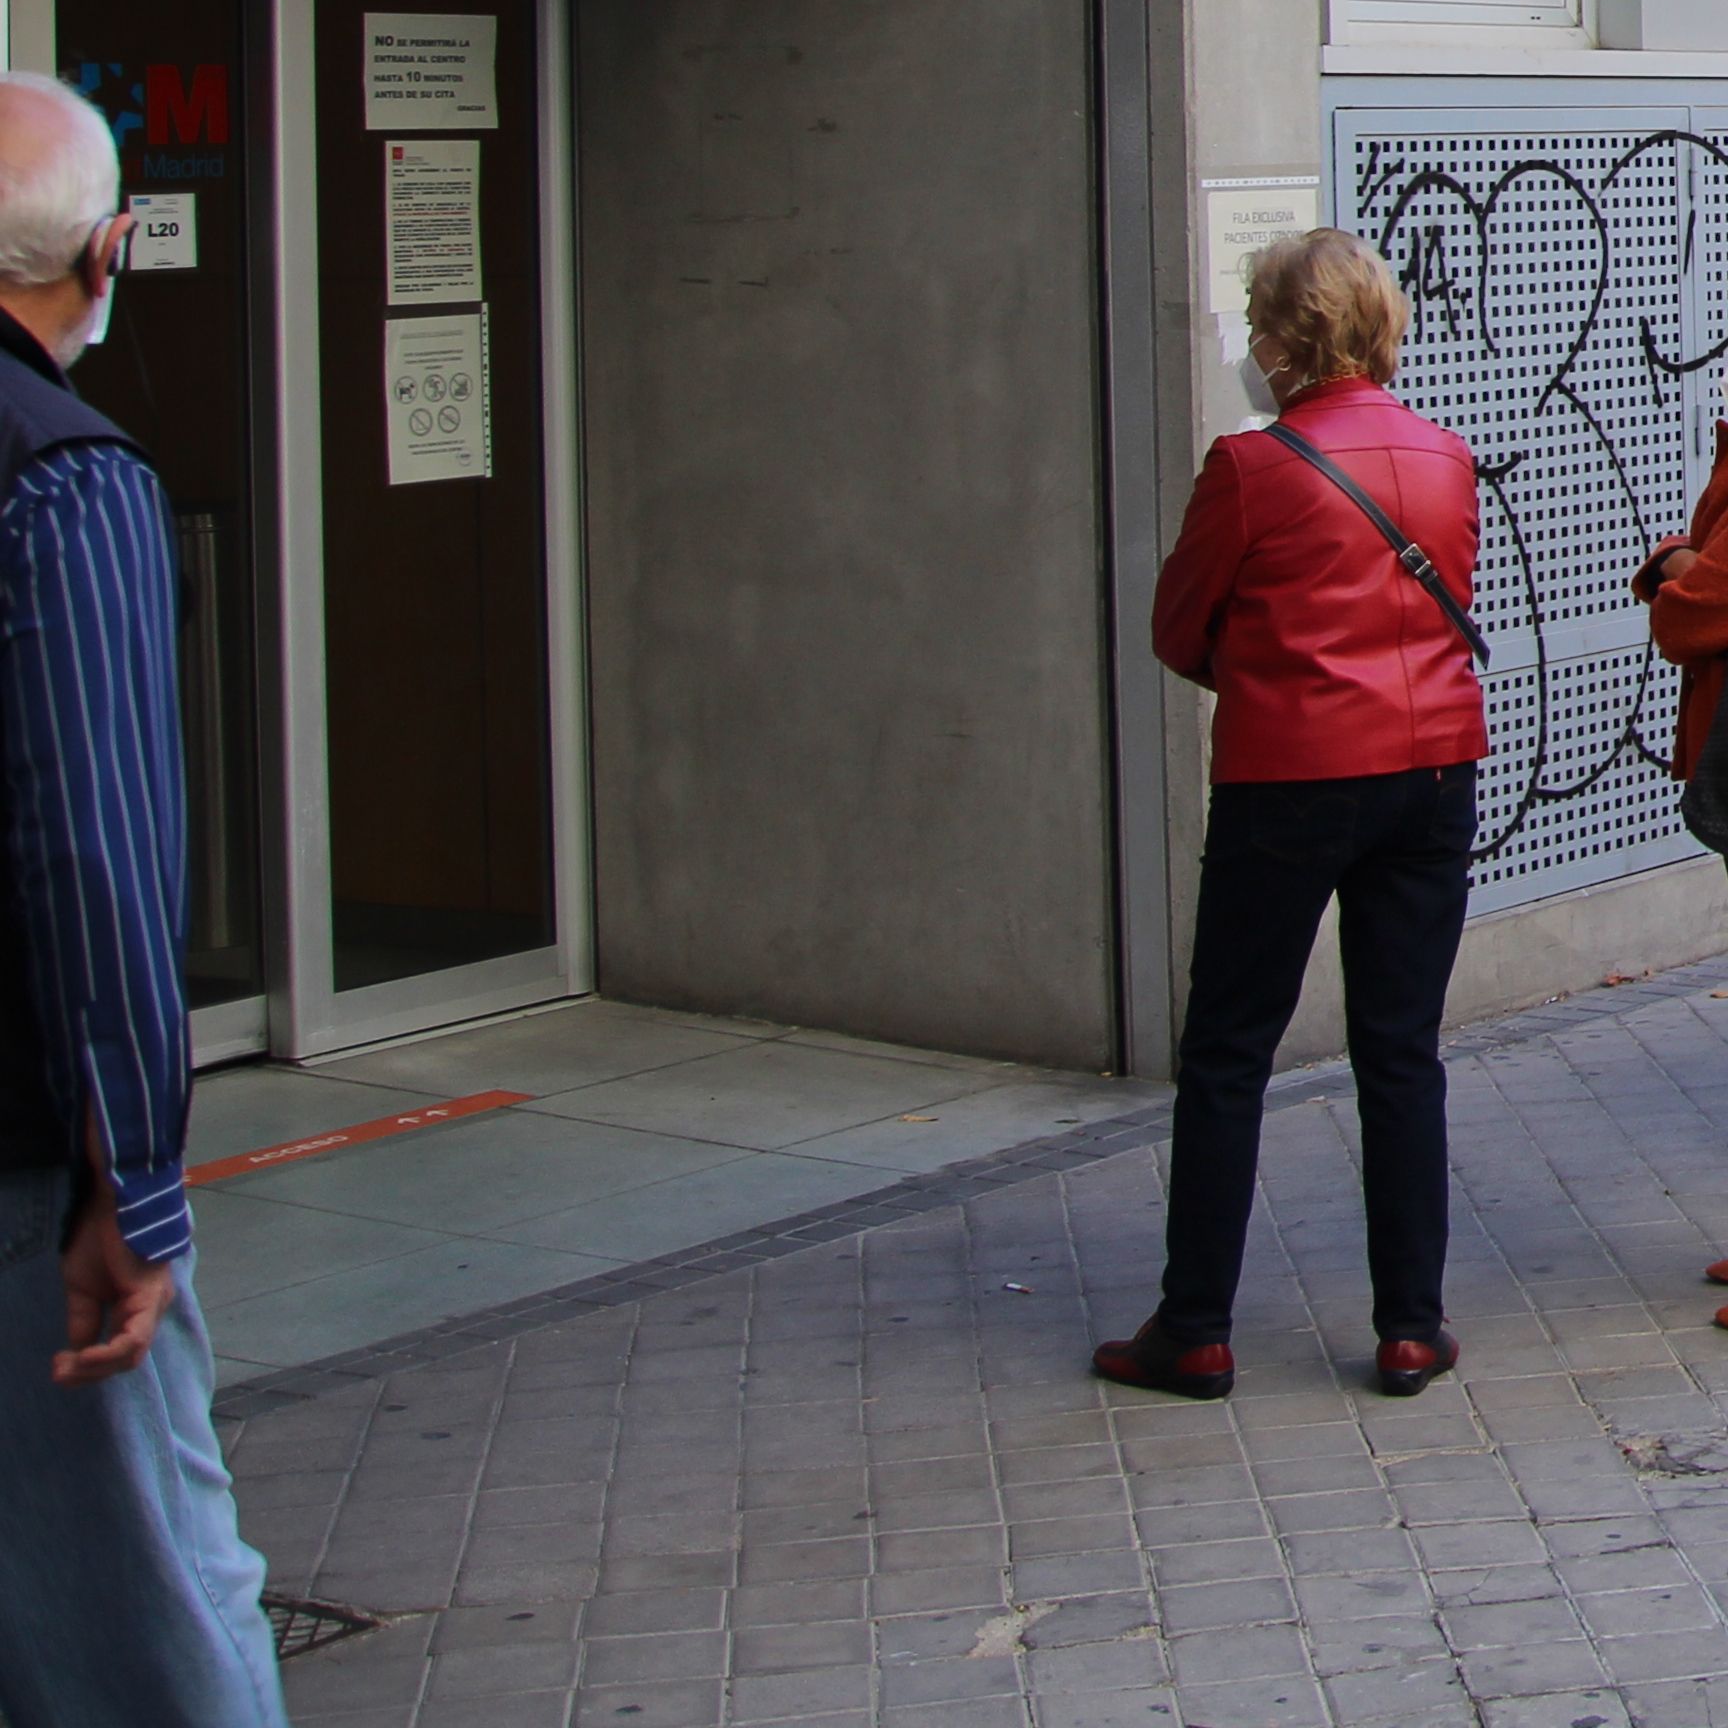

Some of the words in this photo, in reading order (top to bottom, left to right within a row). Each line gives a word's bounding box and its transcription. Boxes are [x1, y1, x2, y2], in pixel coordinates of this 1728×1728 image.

[375, 35, 394, 46] NO
[374, 55, 415, 63] ENTRADA
[417, 55, 428, 63] AL
[406, 71, 421, 82] 10
[1233, 212, 1251, 224] FILA
[1252, 211, 1295, 223] EXCLUSIVA
[148, 223, 179, 237] L20
[1224, 232, 1268, 245] PACIENTES
[250, 1134, 349, 1163] ACCESO
